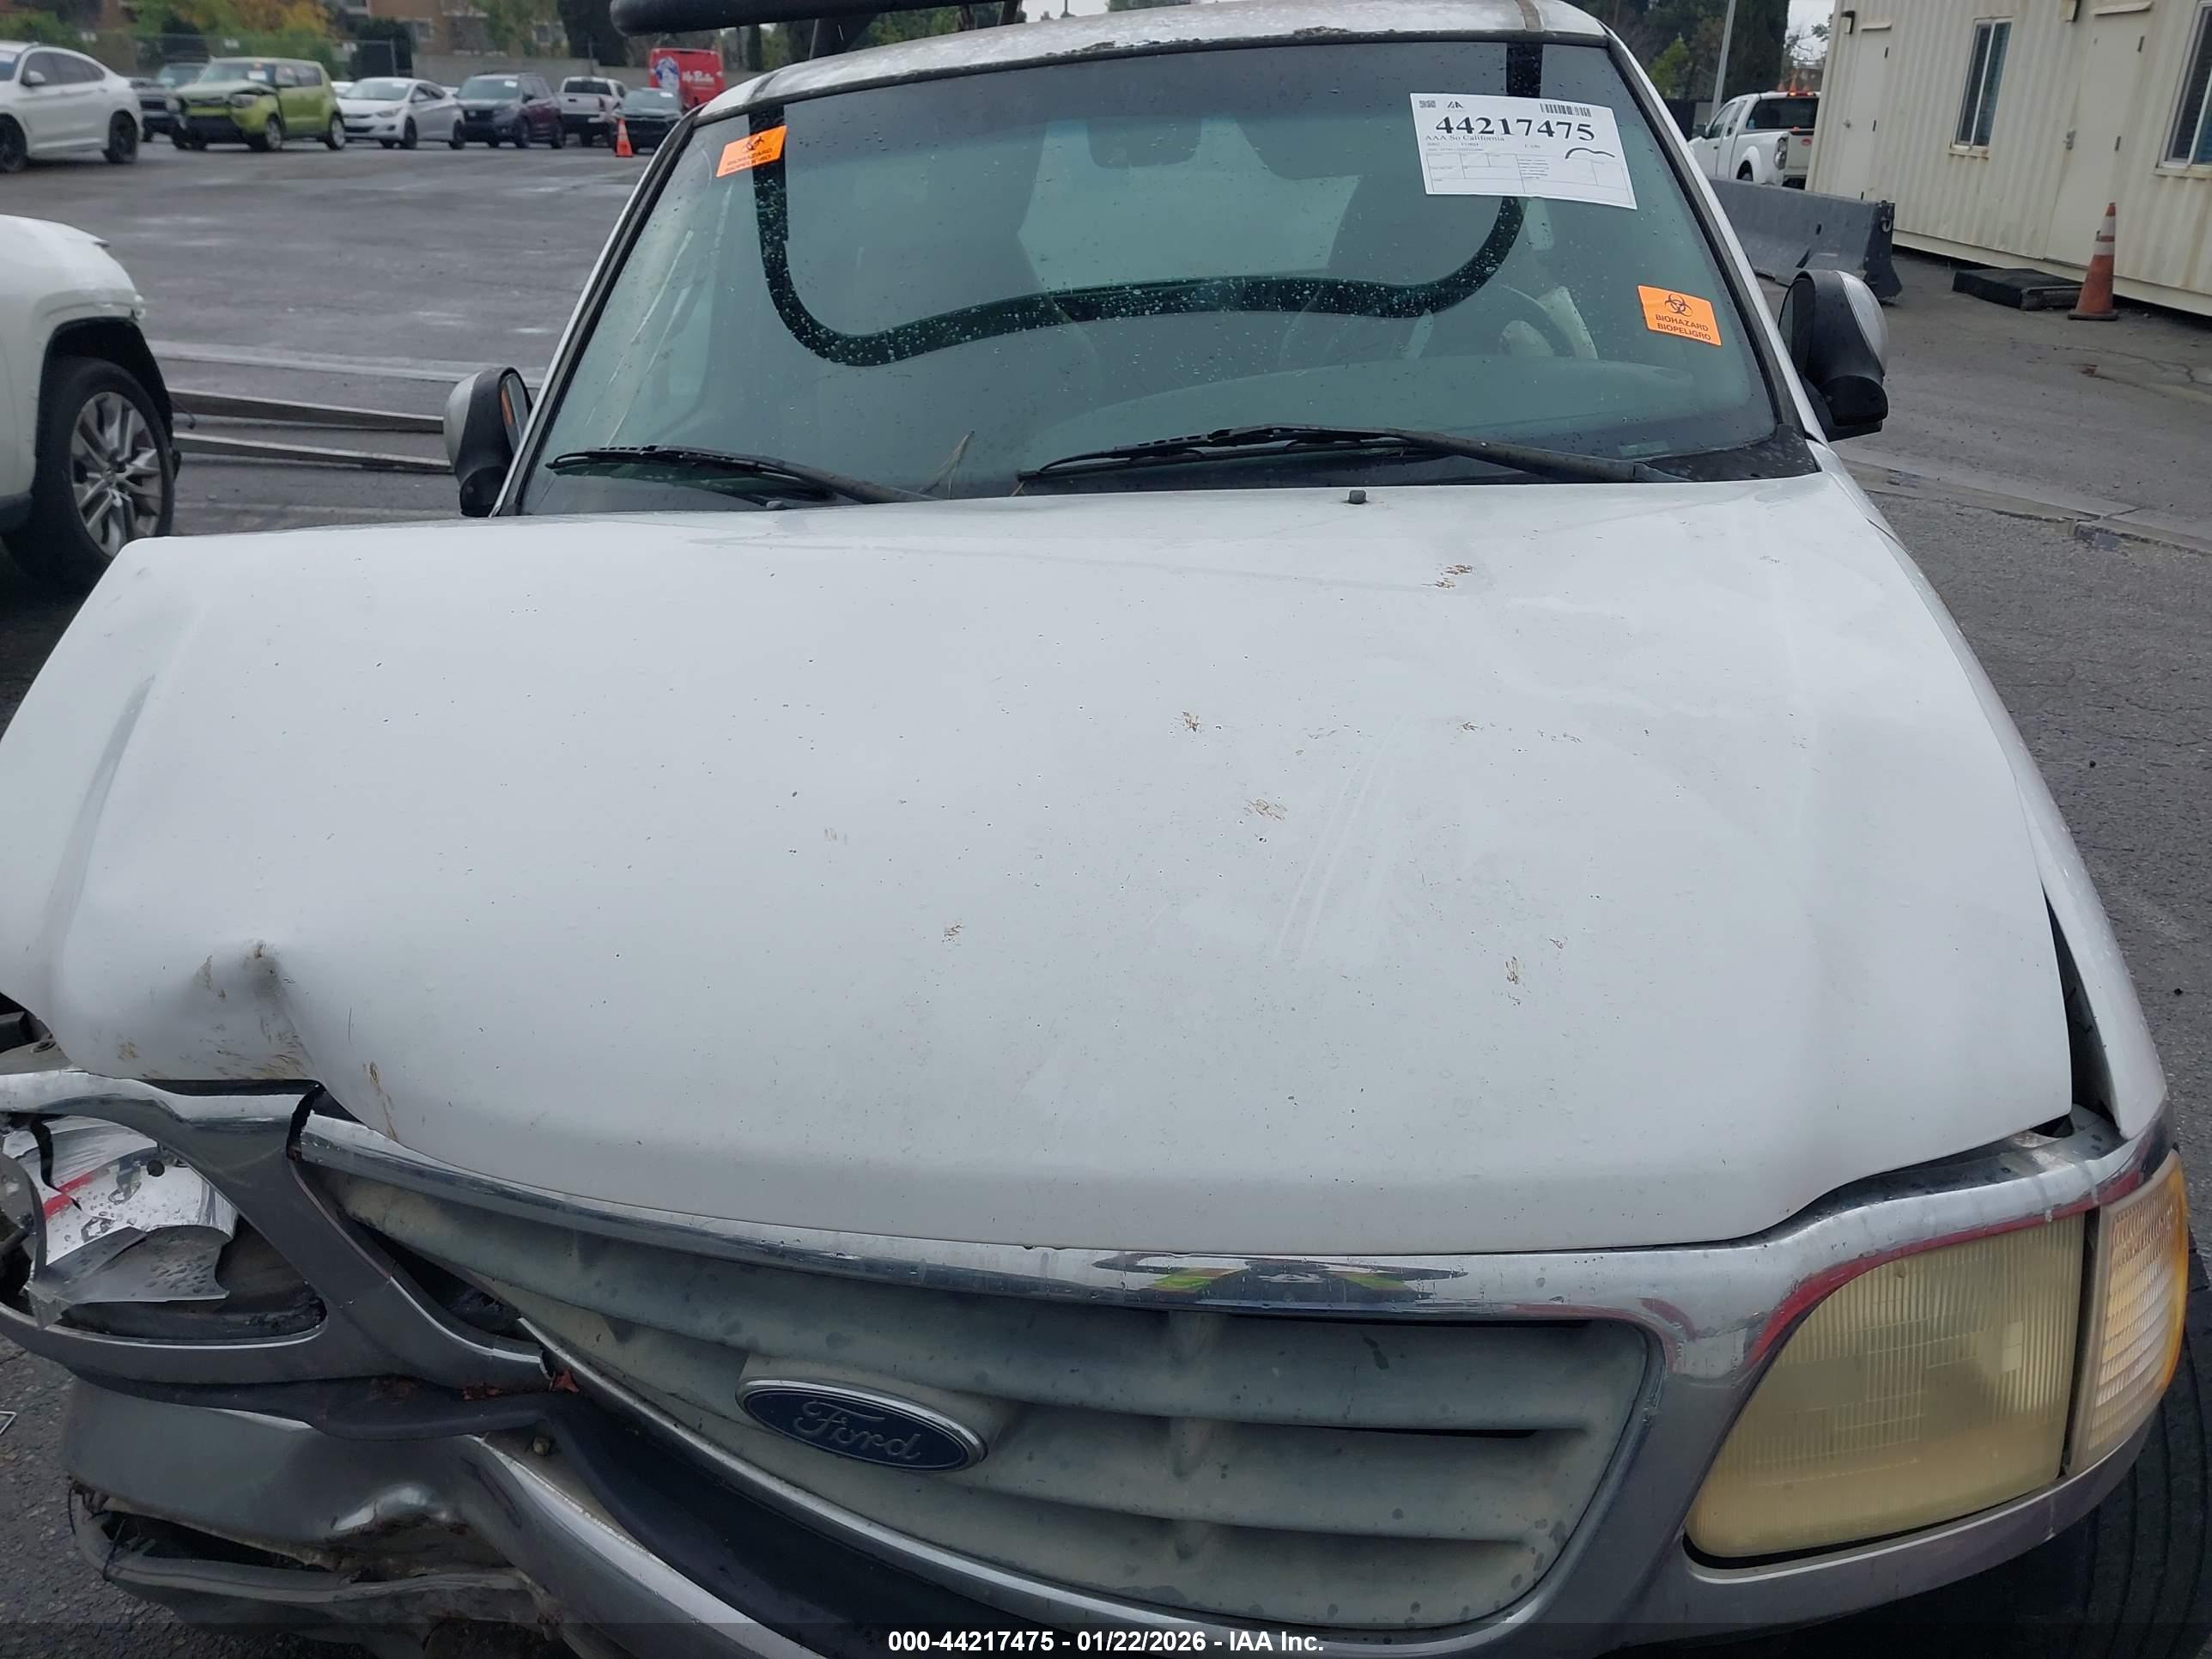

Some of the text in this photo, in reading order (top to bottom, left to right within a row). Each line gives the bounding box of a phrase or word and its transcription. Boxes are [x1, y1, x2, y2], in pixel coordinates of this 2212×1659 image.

[1436, 116, 1595, 142] 44217475
[1655, 313, 1709, 331] BIOHAZARD
[1656, 322, 1711, 341] BIOPELIGRO
[793, 1401, 921, 1460] Ford
